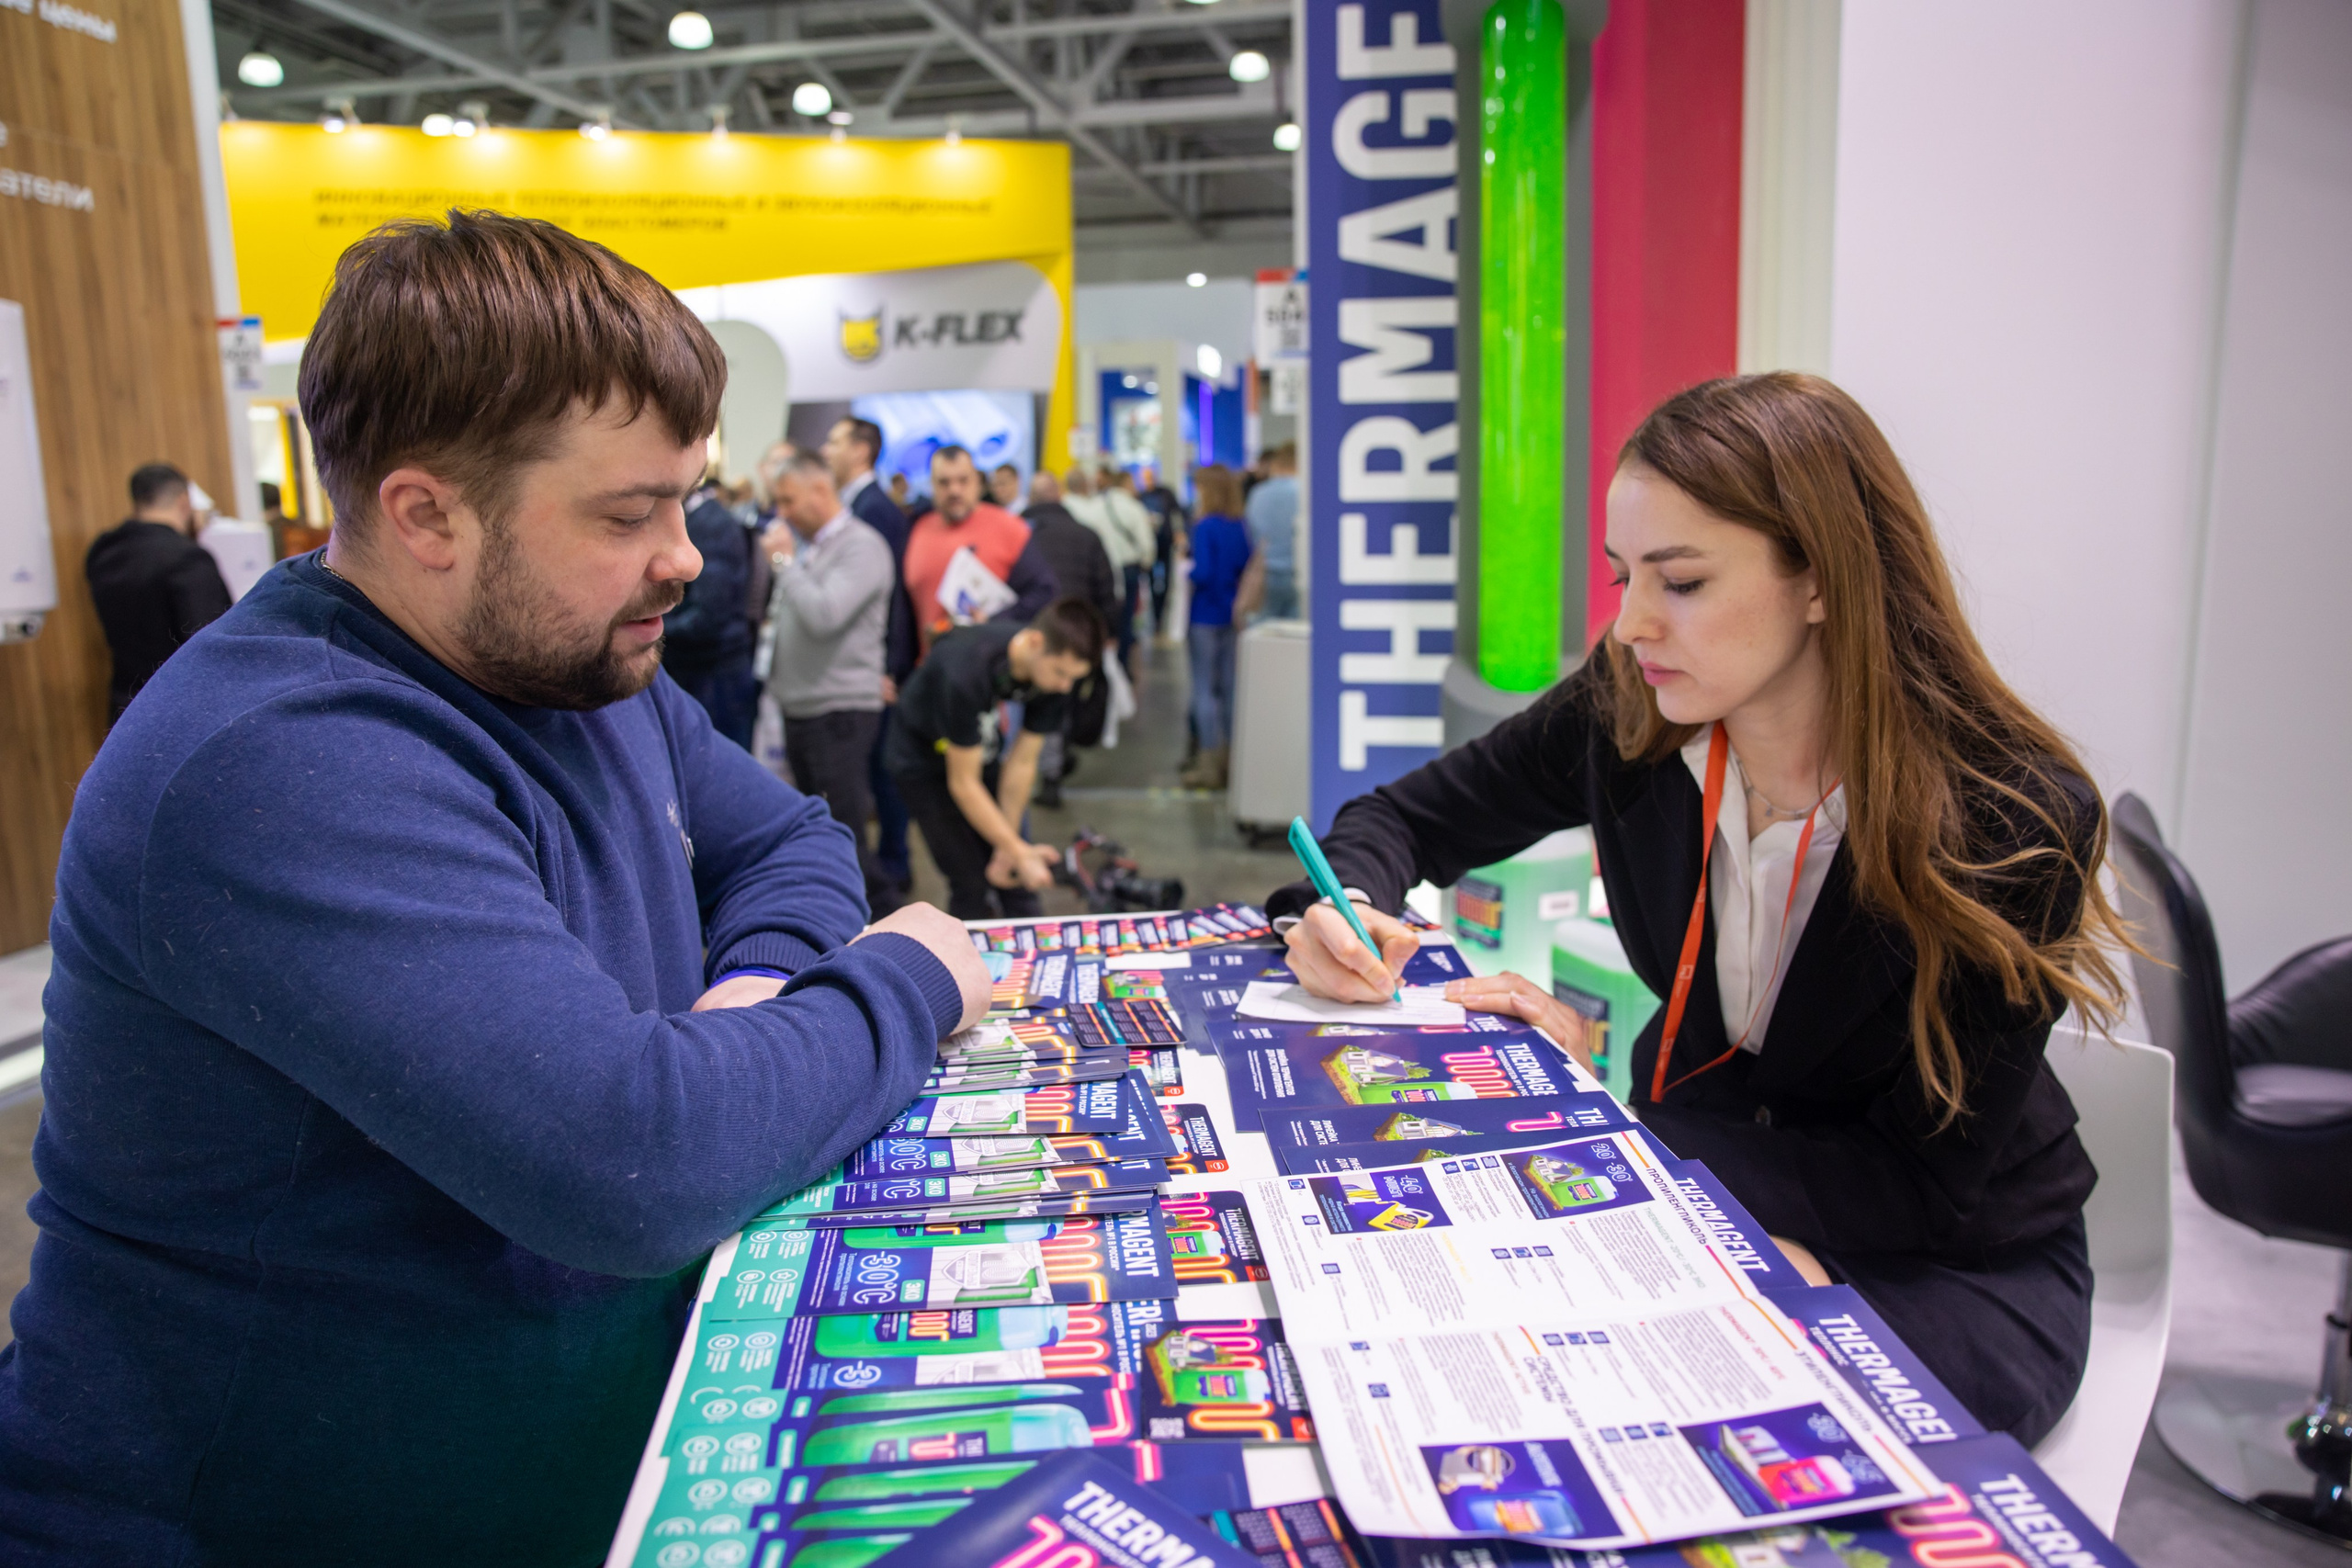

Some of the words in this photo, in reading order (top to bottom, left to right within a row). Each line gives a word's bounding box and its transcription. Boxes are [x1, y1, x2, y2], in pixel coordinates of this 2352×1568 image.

[895, 310, 1026, 348] K-FLEX
[1333, 3, 1460, 772] THERMAGE
[1504, 1043, 1559, 1096] THERMAGE
[909, 1117, 926, 1132] ЭКО
[1189, 1116, 1217, 1157] THERMAGENT
[1574, 1108, 1610, 1127] TH
[932, 1152, 948, 1168] ЭКО
[927, 1181, 943, 1195] ЭКО
[1646, 1168, 1708, 1246] ПРОПИЛЕНГЛИКОЛЬ
[1225, 1207, 1260, 1261] THERMAGENT
[1674, 1177, 1770, 1273] THERMAGENT
[853, 1250, 901, 1304] -30°C
[904, 1281, 922, 1301] ЭКО
